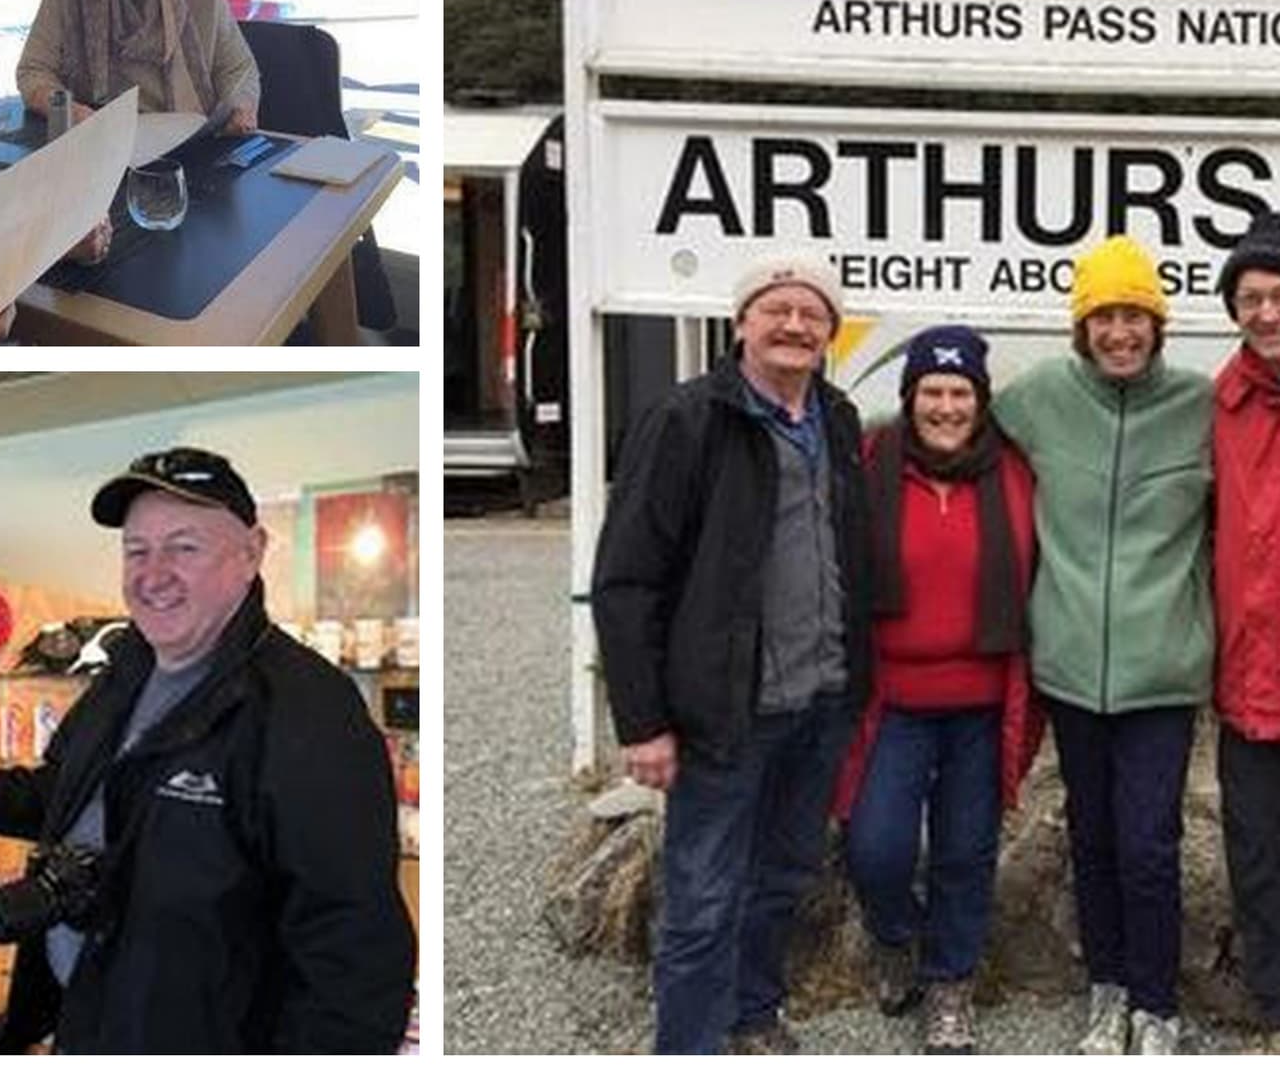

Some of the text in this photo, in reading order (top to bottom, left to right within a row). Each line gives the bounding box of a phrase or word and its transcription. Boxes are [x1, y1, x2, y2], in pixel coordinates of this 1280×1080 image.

[1044, 5, 1157, 44] PASS
[829, 254, 971, 291] EIGHT
[989, 259, 1075, 294] ABO
[1160, 262, 1223, 296] SE
